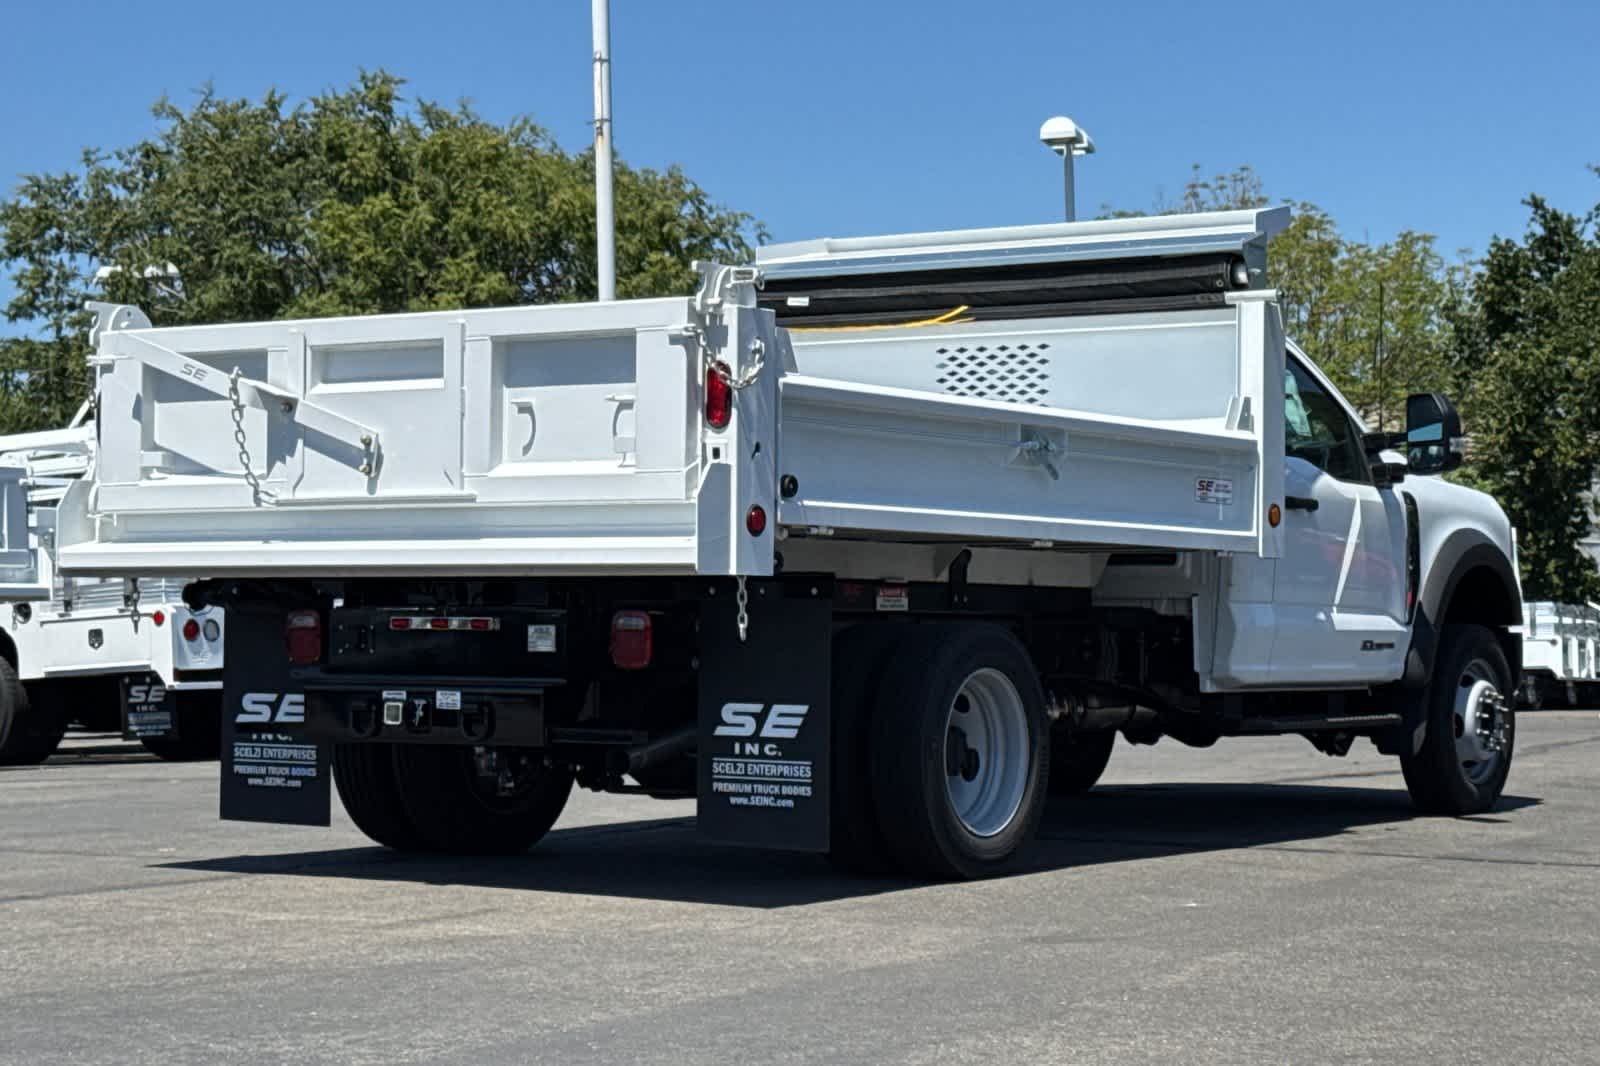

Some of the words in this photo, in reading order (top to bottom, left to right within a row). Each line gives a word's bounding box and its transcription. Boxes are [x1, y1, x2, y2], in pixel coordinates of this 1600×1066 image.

[181, 363, 208, 381] SE
[1198, 480, 1214, 492] SE
[128, 685, 165, 703] SE
[235, 693, 305, 722] SE
[713, 703, 810, 738] SE
[234, 747, 261, 758] SCELZI
[263, 748, 317, 761] ENTERPRISES
[734, 742, 782, 756] INC.
[712, 762, 745, 774] SCELZI
[747, 763, 812, 778] ENTERPRISES
[712, 782, 752, 793] PREMIUM
[753, 784, 780, 795] TRUCK
[781, 785, 812, 797] BODIES
[729, 796, 794, 808] www.SEINC.com
